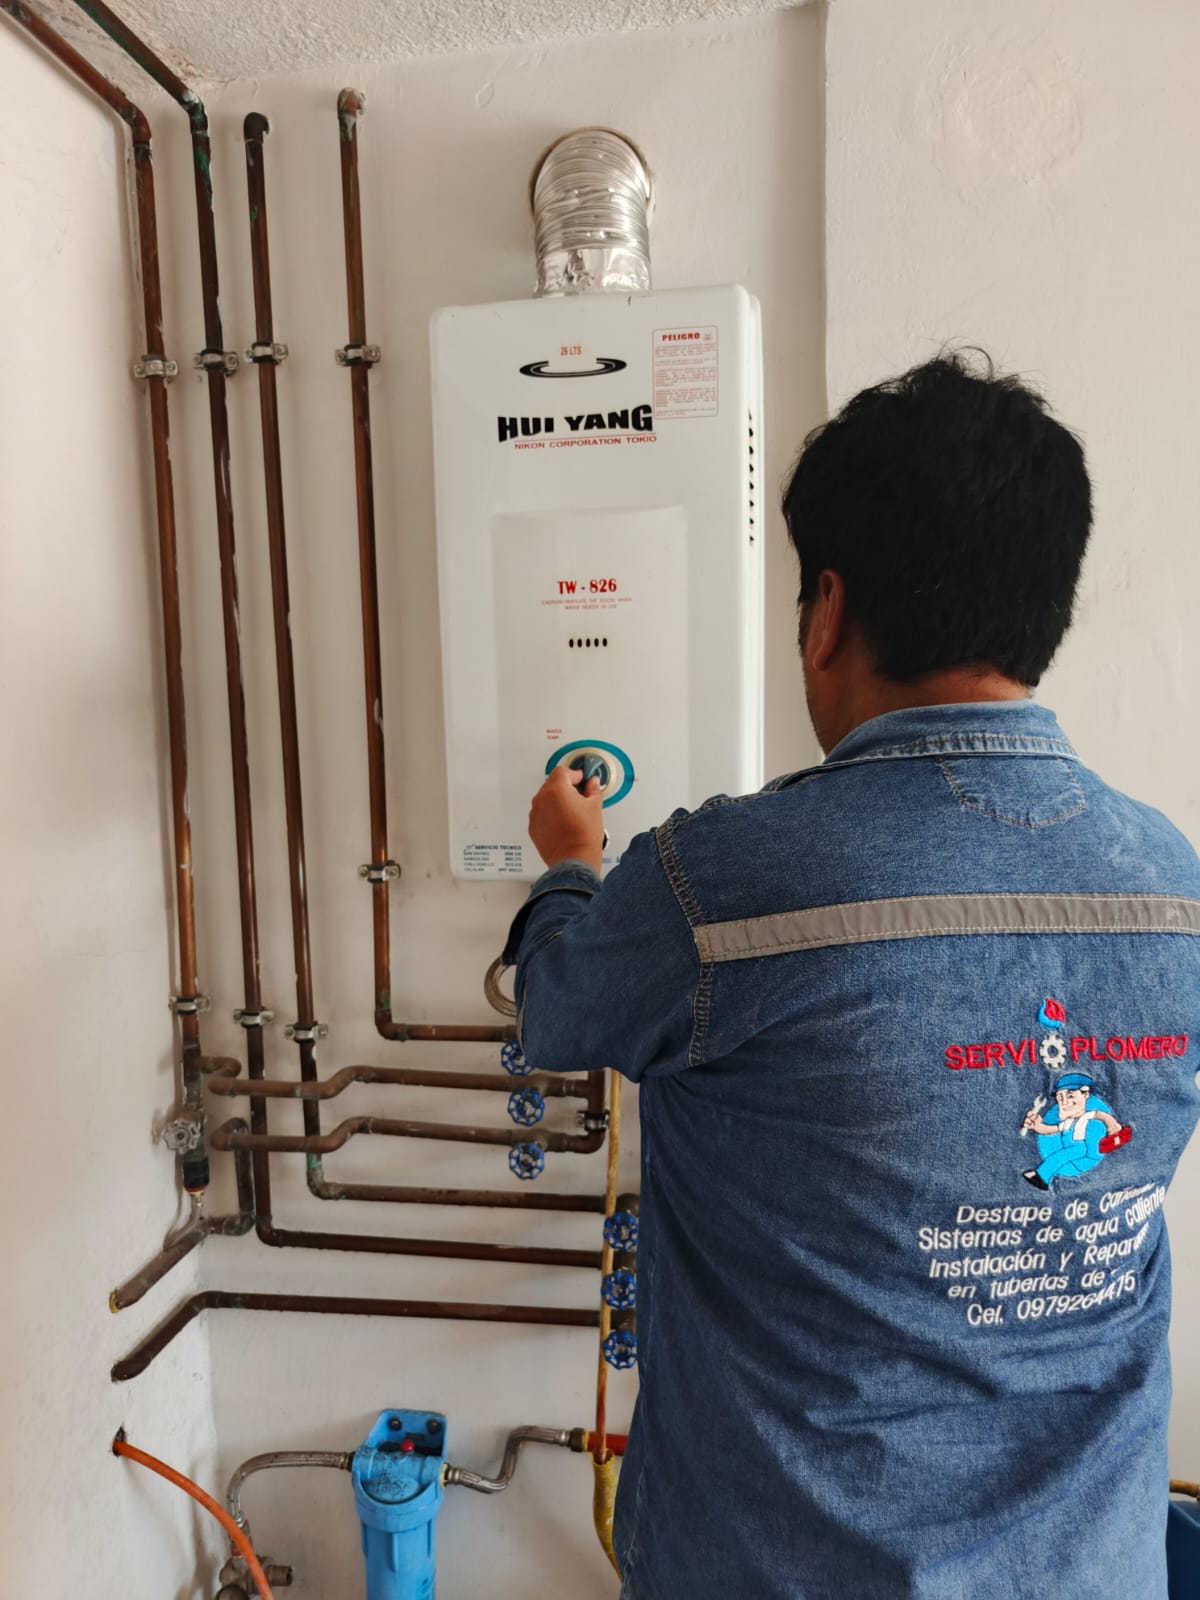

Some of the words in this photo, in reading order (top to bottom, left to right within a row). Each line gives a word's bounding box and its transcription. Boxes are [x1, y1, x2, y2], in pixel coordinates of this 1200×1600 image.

[569, 346, 582, 356] LTS
[662, 332, 700, 342] PELIGRO
[498, 416, 554, 442] HUI
[564, 404, 653, 432] YANG
[514, 442, 546, 450] NIKON
[549, 438, 622, 448] CORPORATION
[626, 434, 657, 444] TOKIO
[557, 580, 577, 594] TW
[588, 578, 617, 594] 826
[946, 1039, 1038, 1070] SERVI
[1070, 1033, 1188, 1062] PLOMERO
[918, 1226, 1022, 1250] Sistemas
[1035, 1226, 1064, 1244] de
[1074, 1216, 1119, 1244] agua
[1124, 1186, 1166, 1228] caliente
[956, 1206, 1052, 1228] Destape
[1064, 1198, 1088, 1220] de
[928, 1248, 1046, 1278] Instalación
[1059, 1252, 1074, 1272] y
[948, 1284, 976, 1299] en
[1081, 1270, 1106, 1288] de
[966, 1303, 1004, 1326] Cel.
